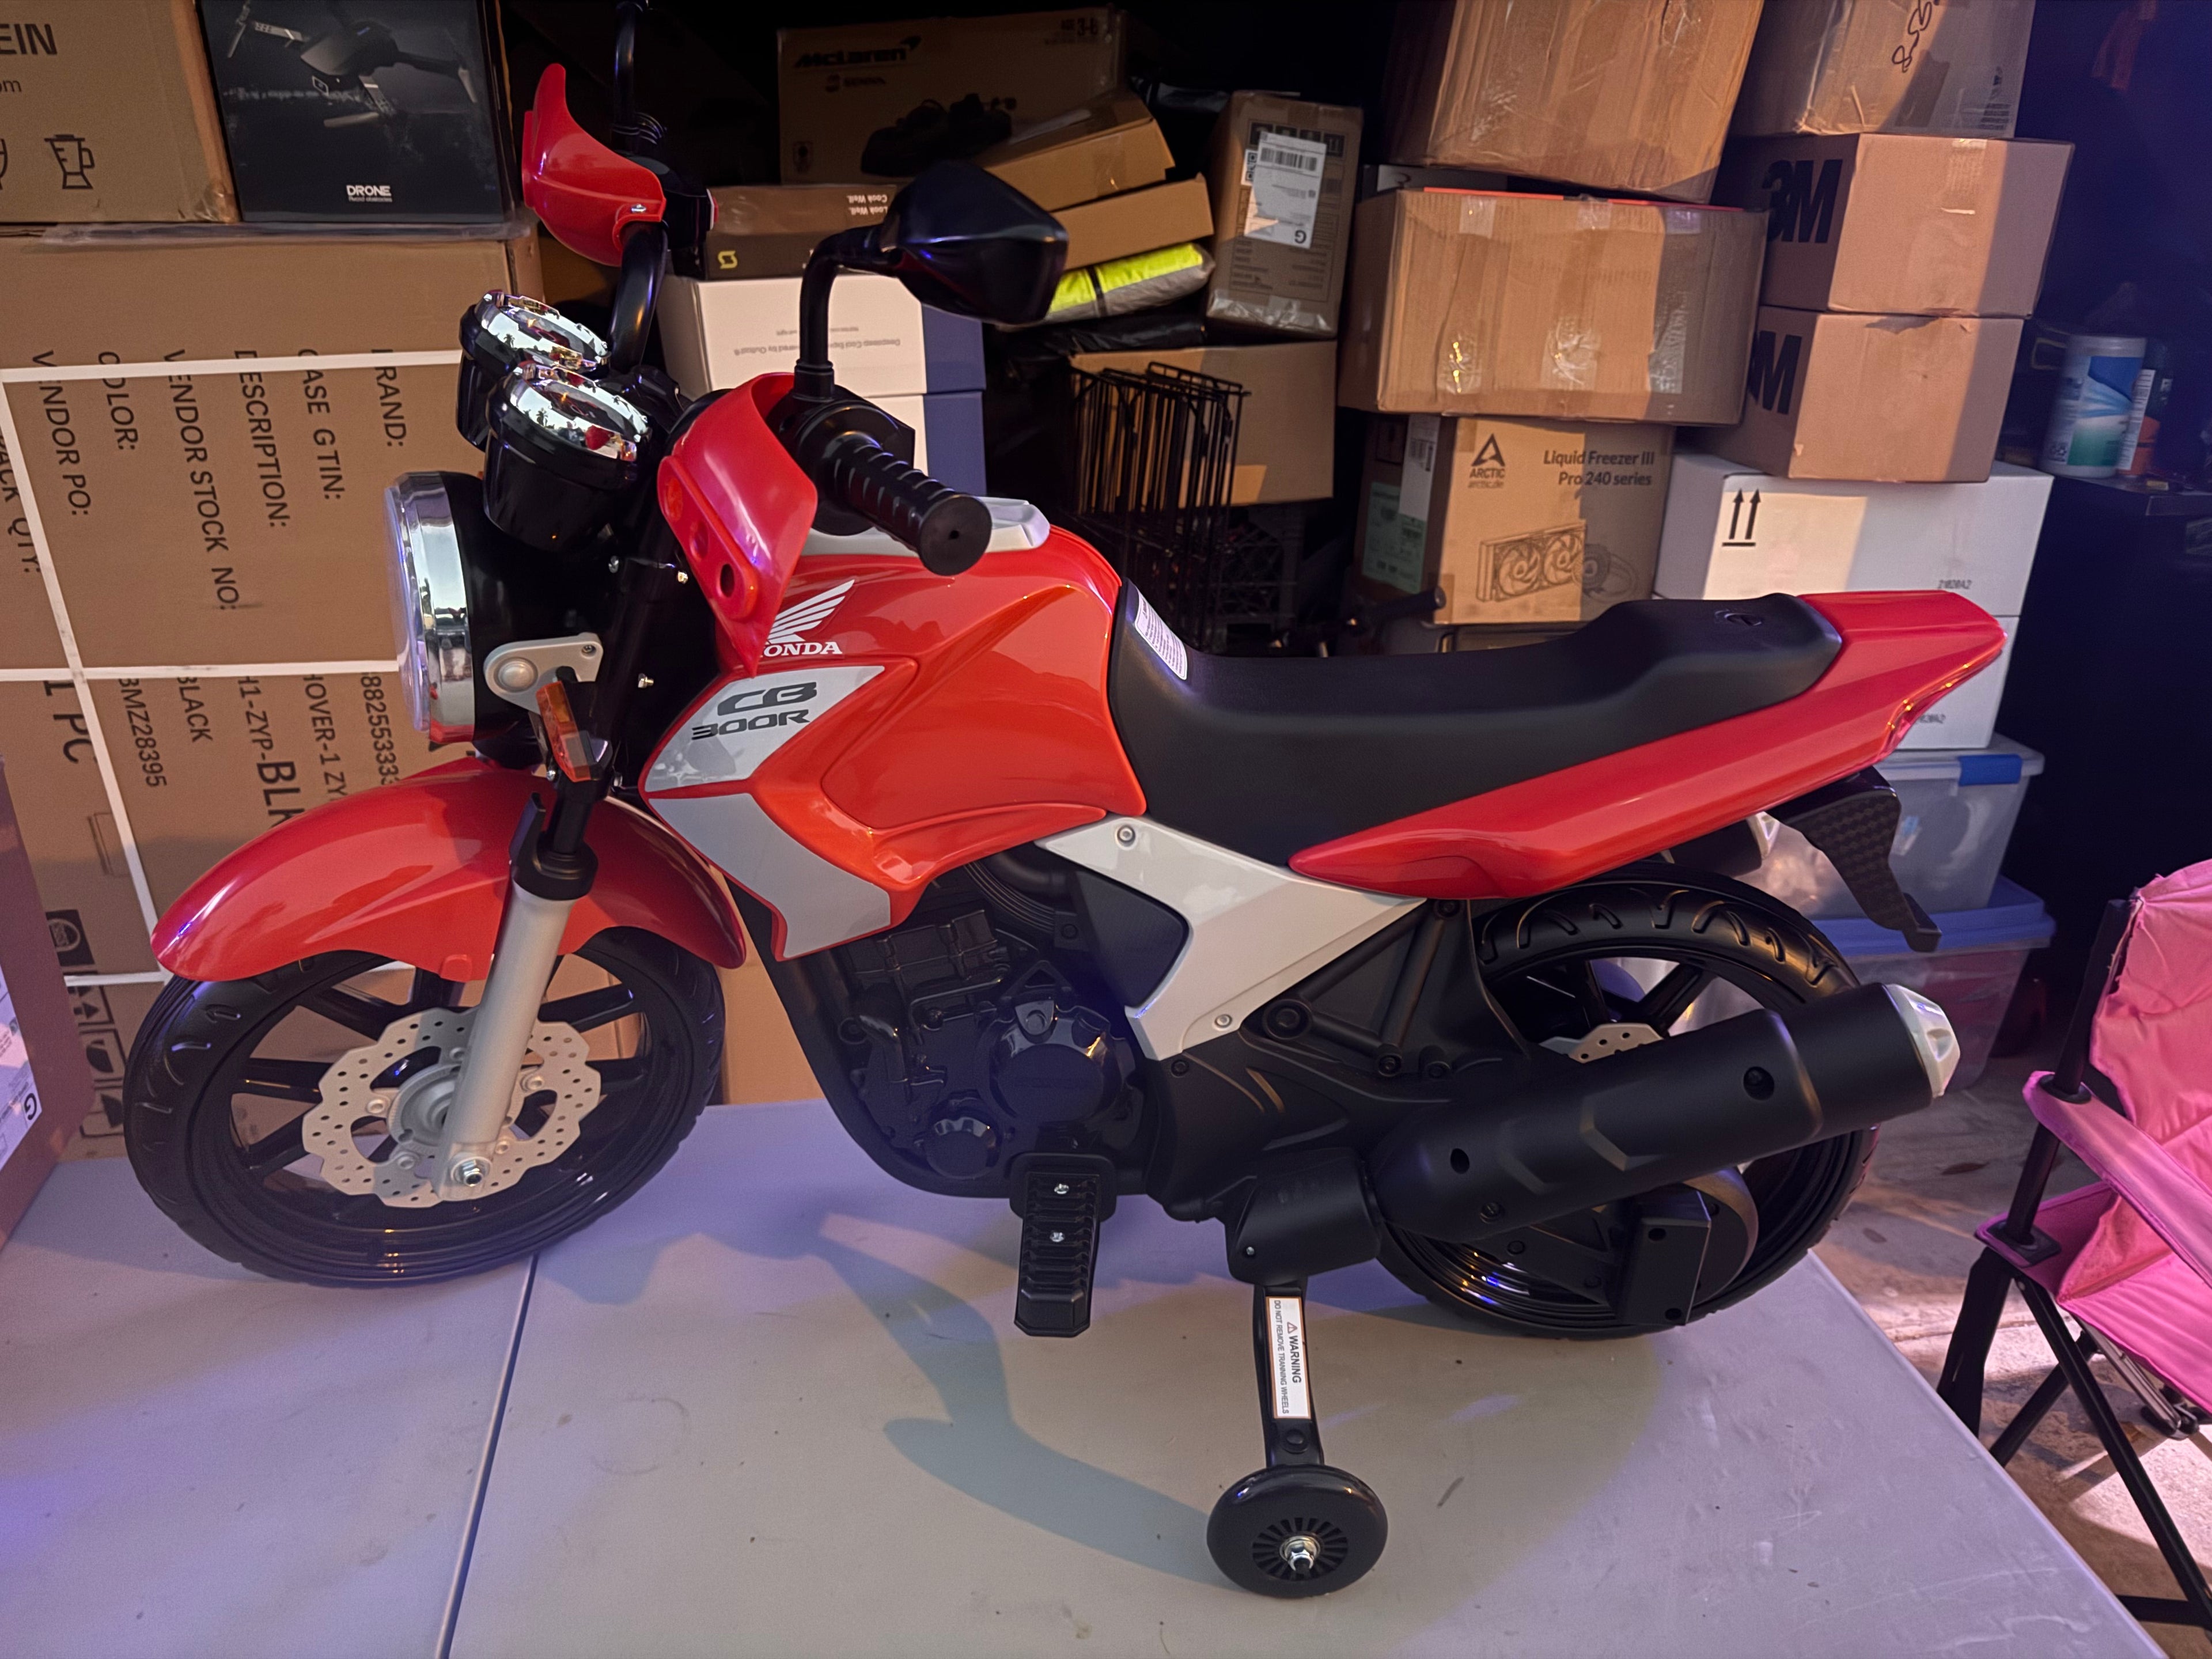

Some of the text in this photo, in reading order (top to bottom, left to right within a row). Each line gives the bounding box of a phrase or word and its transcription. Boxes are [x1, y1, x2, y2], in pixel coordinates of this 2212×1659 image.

[0, 80, 22, 92] m
[346, 184, 392, 196] DRONE
[1294, 229, 1307, 244] G
[372, 350, 407, 447] RAND:
[32, 350, 91, 516] VNDOR PO:
[312, 429, 345, 500] GTIN:
[1543, 450, 1655, 467] Liquid Freezer III
[1469, 468, 1506, 479] ARCTIC
[1558, 471, 1653, 486] Pro 240 series
[190, 470, 229, 553] STOCK
[211, 567, 240, 610] NO:
[177, 677, 213, 743] BLACK
[717, 681, 817, 716] CB
[691, 709, 811, 740] 300R
[324, 771, 348, 801] ZY
[24, 1093, 37, 1120] G
[1274, 1300, 1281, 1309] DO
[1275, 1310, 1283, 1324] NOT
[1276, 1324, 1285, 1351] REMOVE
[1289, 1335, 1302, 1384] WARNING
[1280, 1387, 1289, 1414] WHEELS
